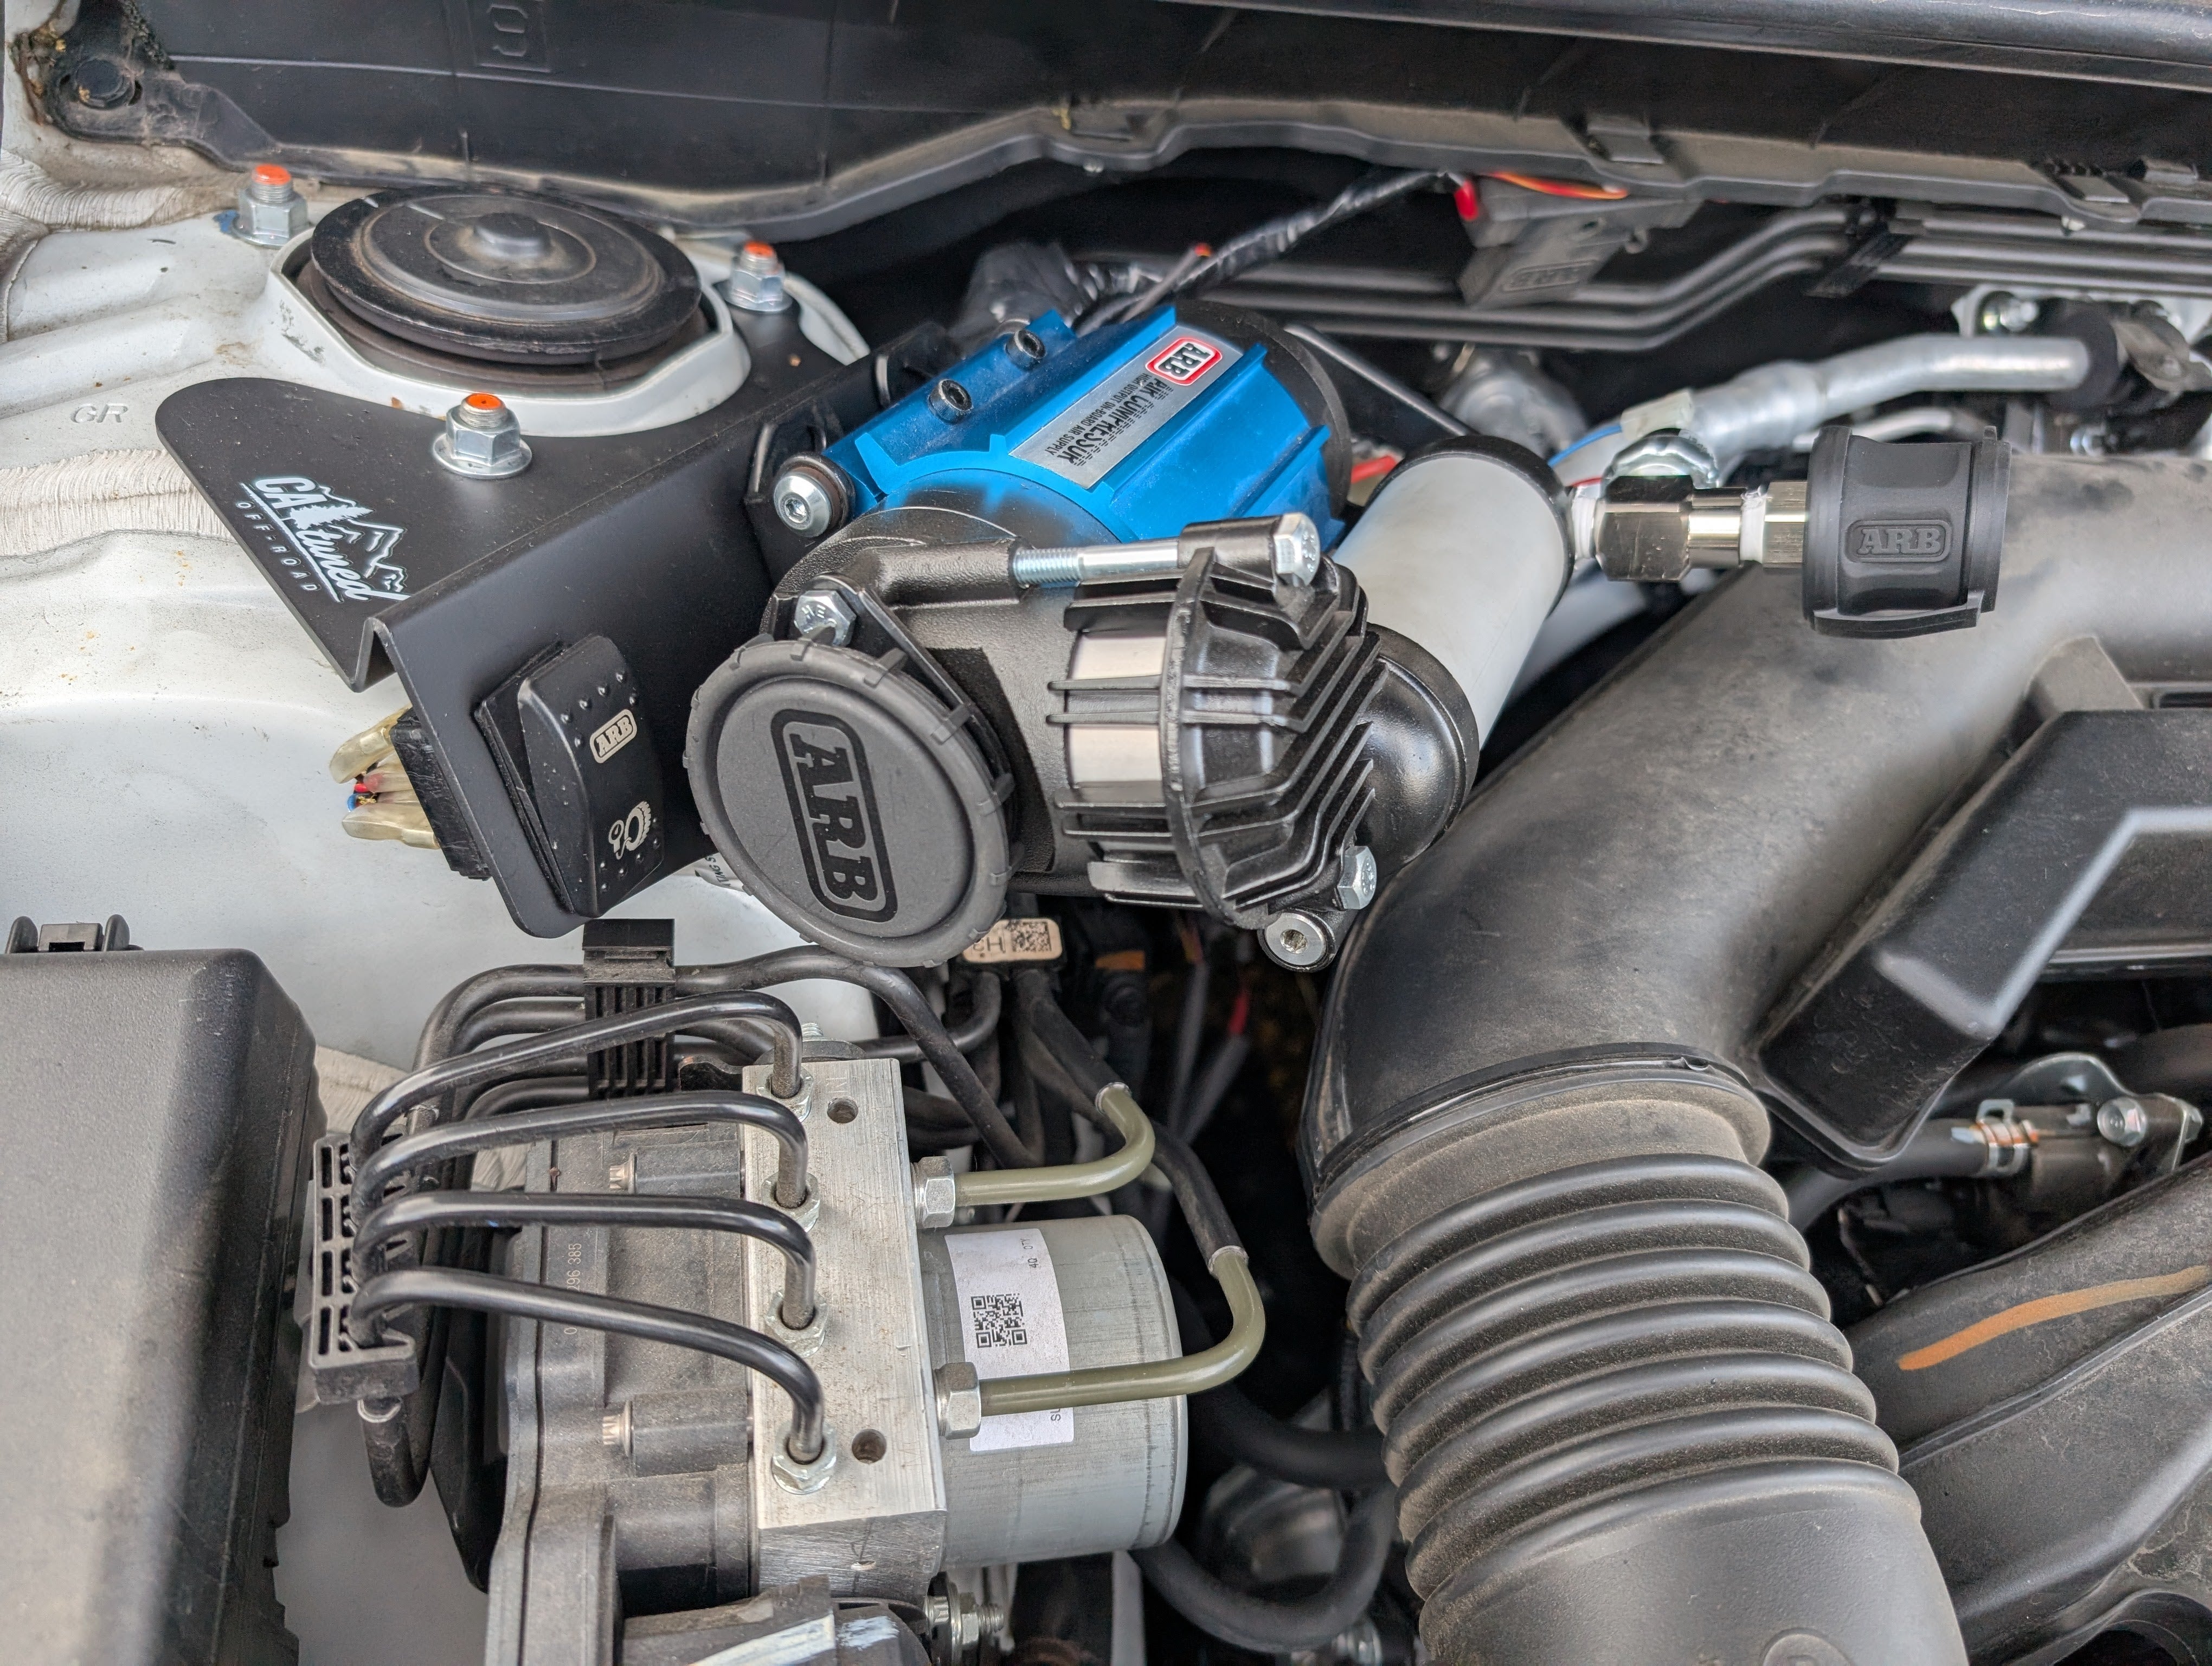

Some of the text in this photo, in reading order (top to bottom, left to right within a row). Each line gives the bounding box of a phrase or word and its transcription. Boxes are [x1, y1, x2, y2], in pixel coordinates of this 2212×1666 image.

[1158, 342, 1211, 378] ARB
[1113, 384, 1139, 403] OUTPUT
[70, 403, 129, 423] GR
[1057, 378, 1174, 466] AIR COMPRESSOR
[1081, 401, 1116, 426] ON-BOARD
[1068, 424, 1085, 435] AIR
[1044, 434, 1075, 456] SUPPLY
[1856, 528, 1941, 555] ARB
[595, 716, 633, 757] ARB
[789, 733, 878, 901] ARB
[568, 1243, 582, 1265] 385
